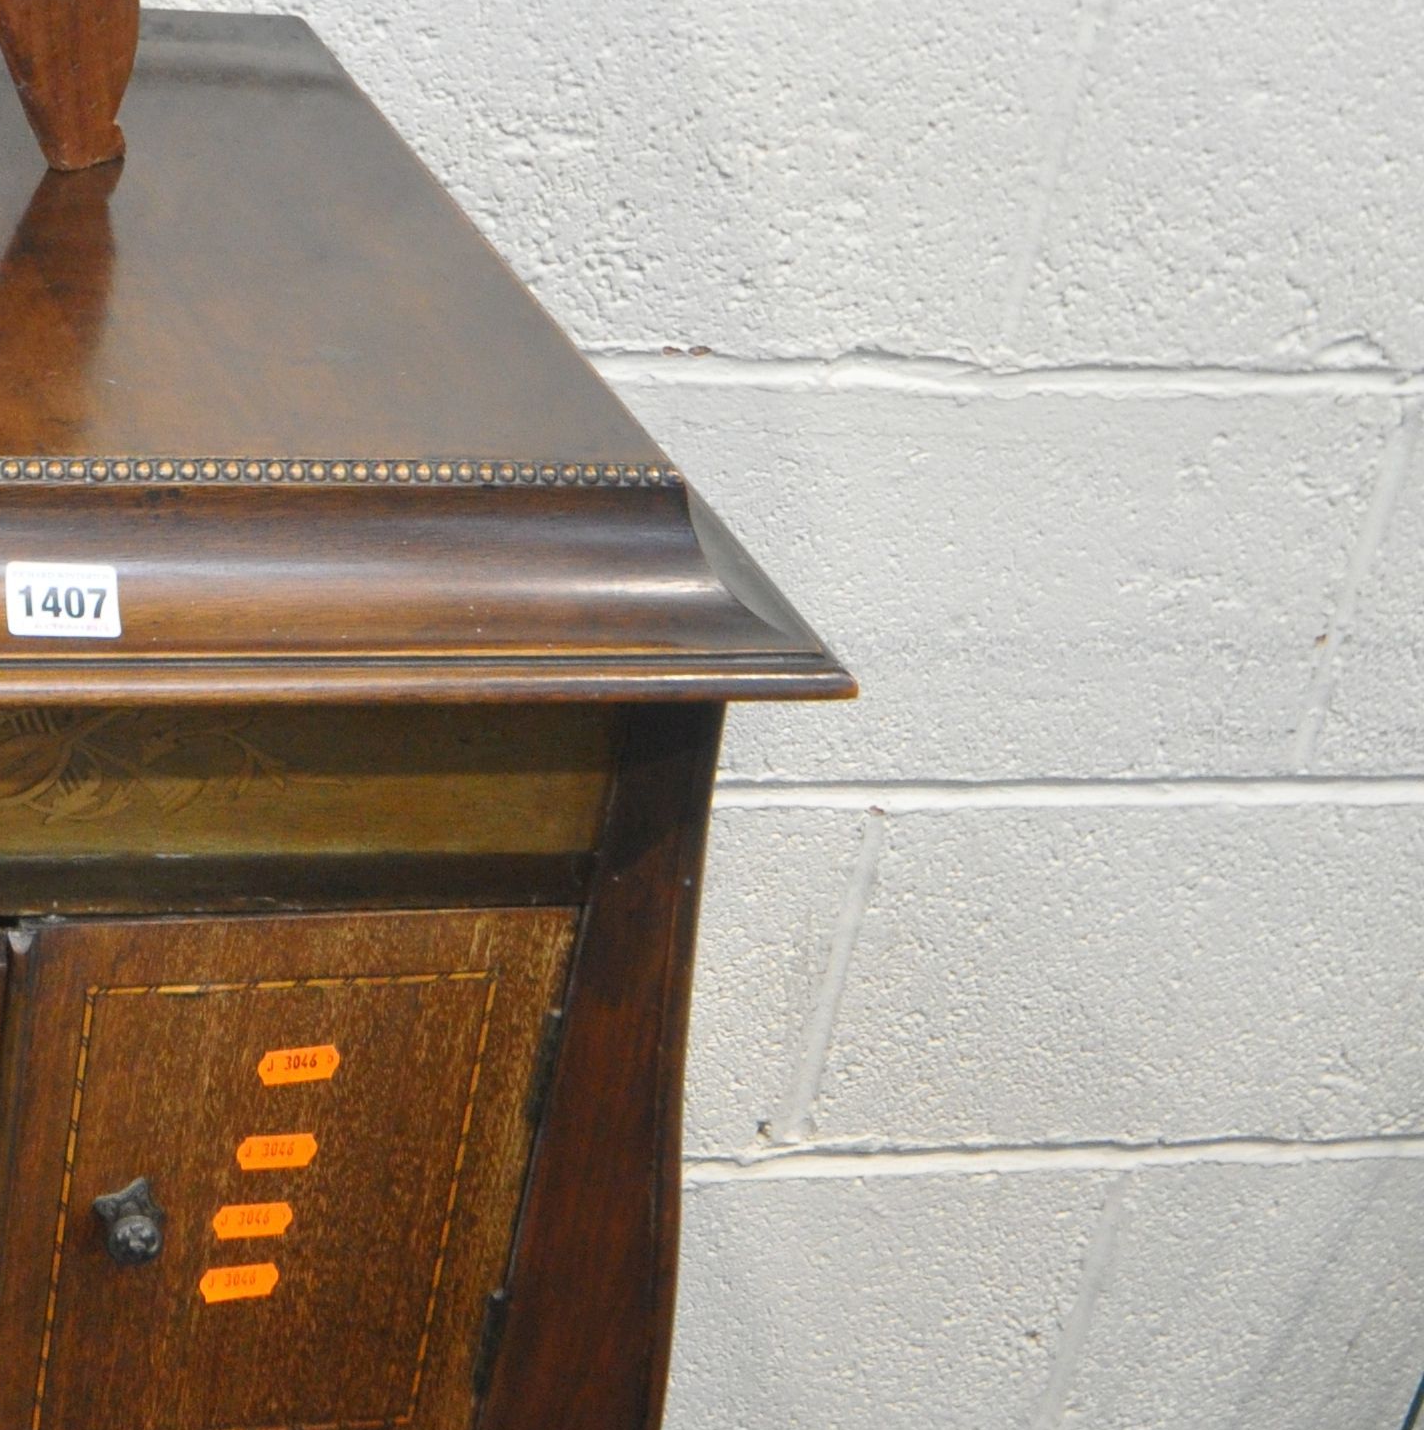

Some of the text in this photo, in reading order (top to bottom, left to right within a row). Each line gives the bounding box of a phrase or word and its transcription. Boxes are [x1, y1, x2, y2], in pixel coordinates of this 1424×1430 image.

[18, 585, 108, 619] 1407
[284, 1053, 318, 1070] 3046
[261, 1141, 295, 1157] 3046
[238, 1210, 270, 1226] 3046
